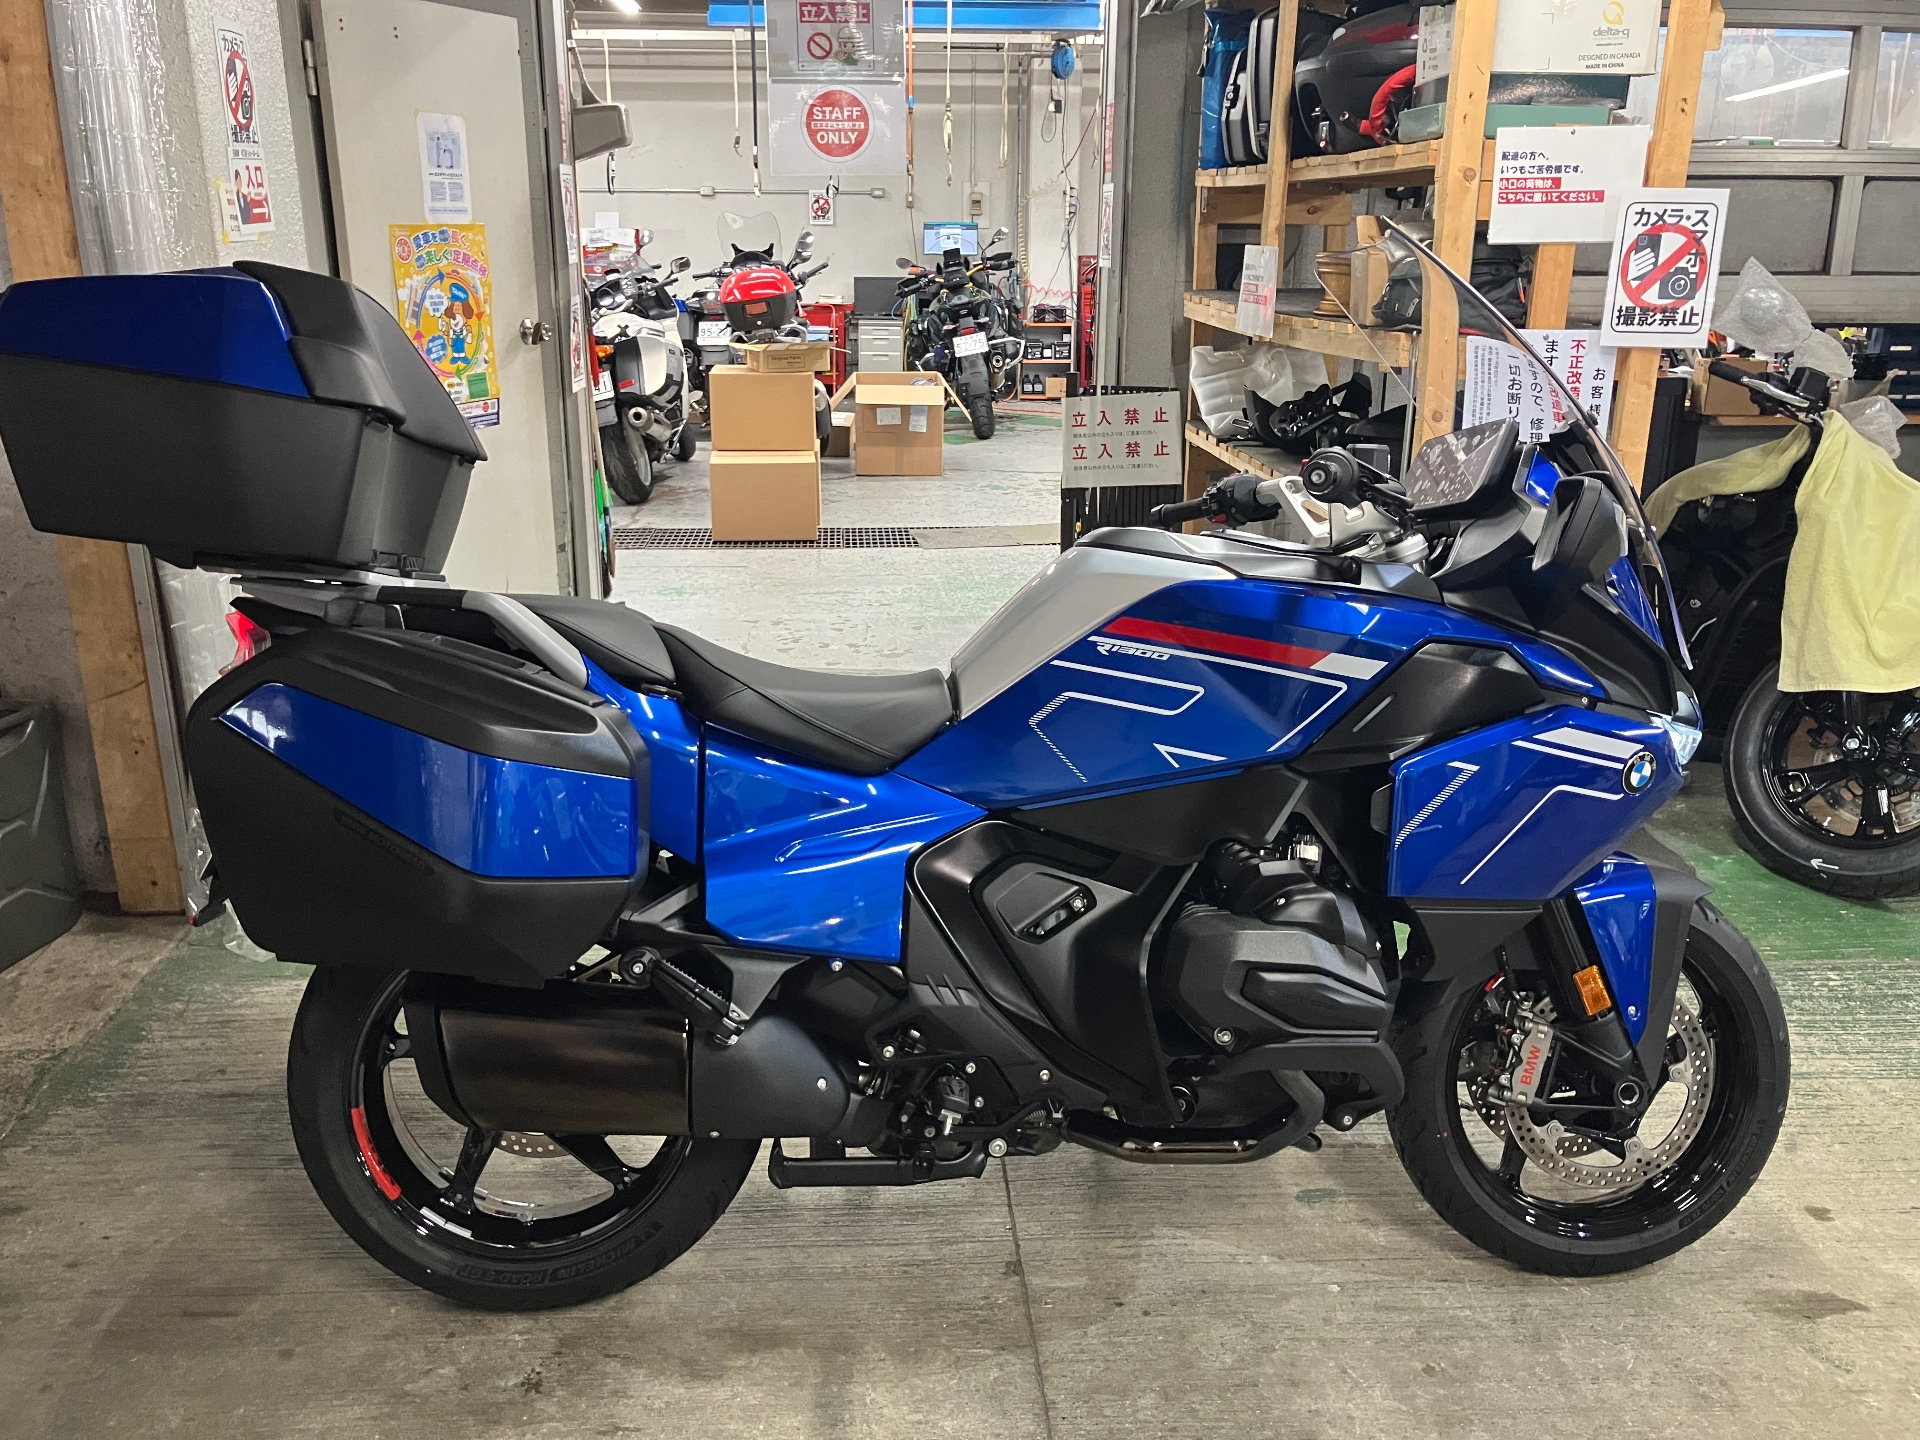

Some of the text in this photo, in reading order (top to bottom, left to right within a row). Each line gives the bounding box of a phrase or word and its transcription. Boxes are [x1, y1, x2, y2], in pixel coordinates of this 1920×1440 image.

[801, 4, 868, 22] 立入禁止
[1592, 27, 1630, 39] delta-q
[1616, 52, 1641, 60] CANADA
[812, 106, 862, 120] STAFF
[816, 131, 858, 145] ONLY
[1501, 151, 1550, 161] 配達の方へ。
[1500, 165, 1584, 175] いつもご苦労様です。
[245, 165, 264, 190] 入口
[1499, 178, 1557, 189] 小口の荷物は、
[1498, 191, 1599, 203] こちらに置いてください。
[1615, 305, 1700, 327] 撮影禁止
[1072, 406, 1169, 428] 立入禁止
[1072, 440, 1170, 460] 立入禁止
[1096, 641, 1171, 661] R1300
[1520, 1044, 1542, 1086] BMW
